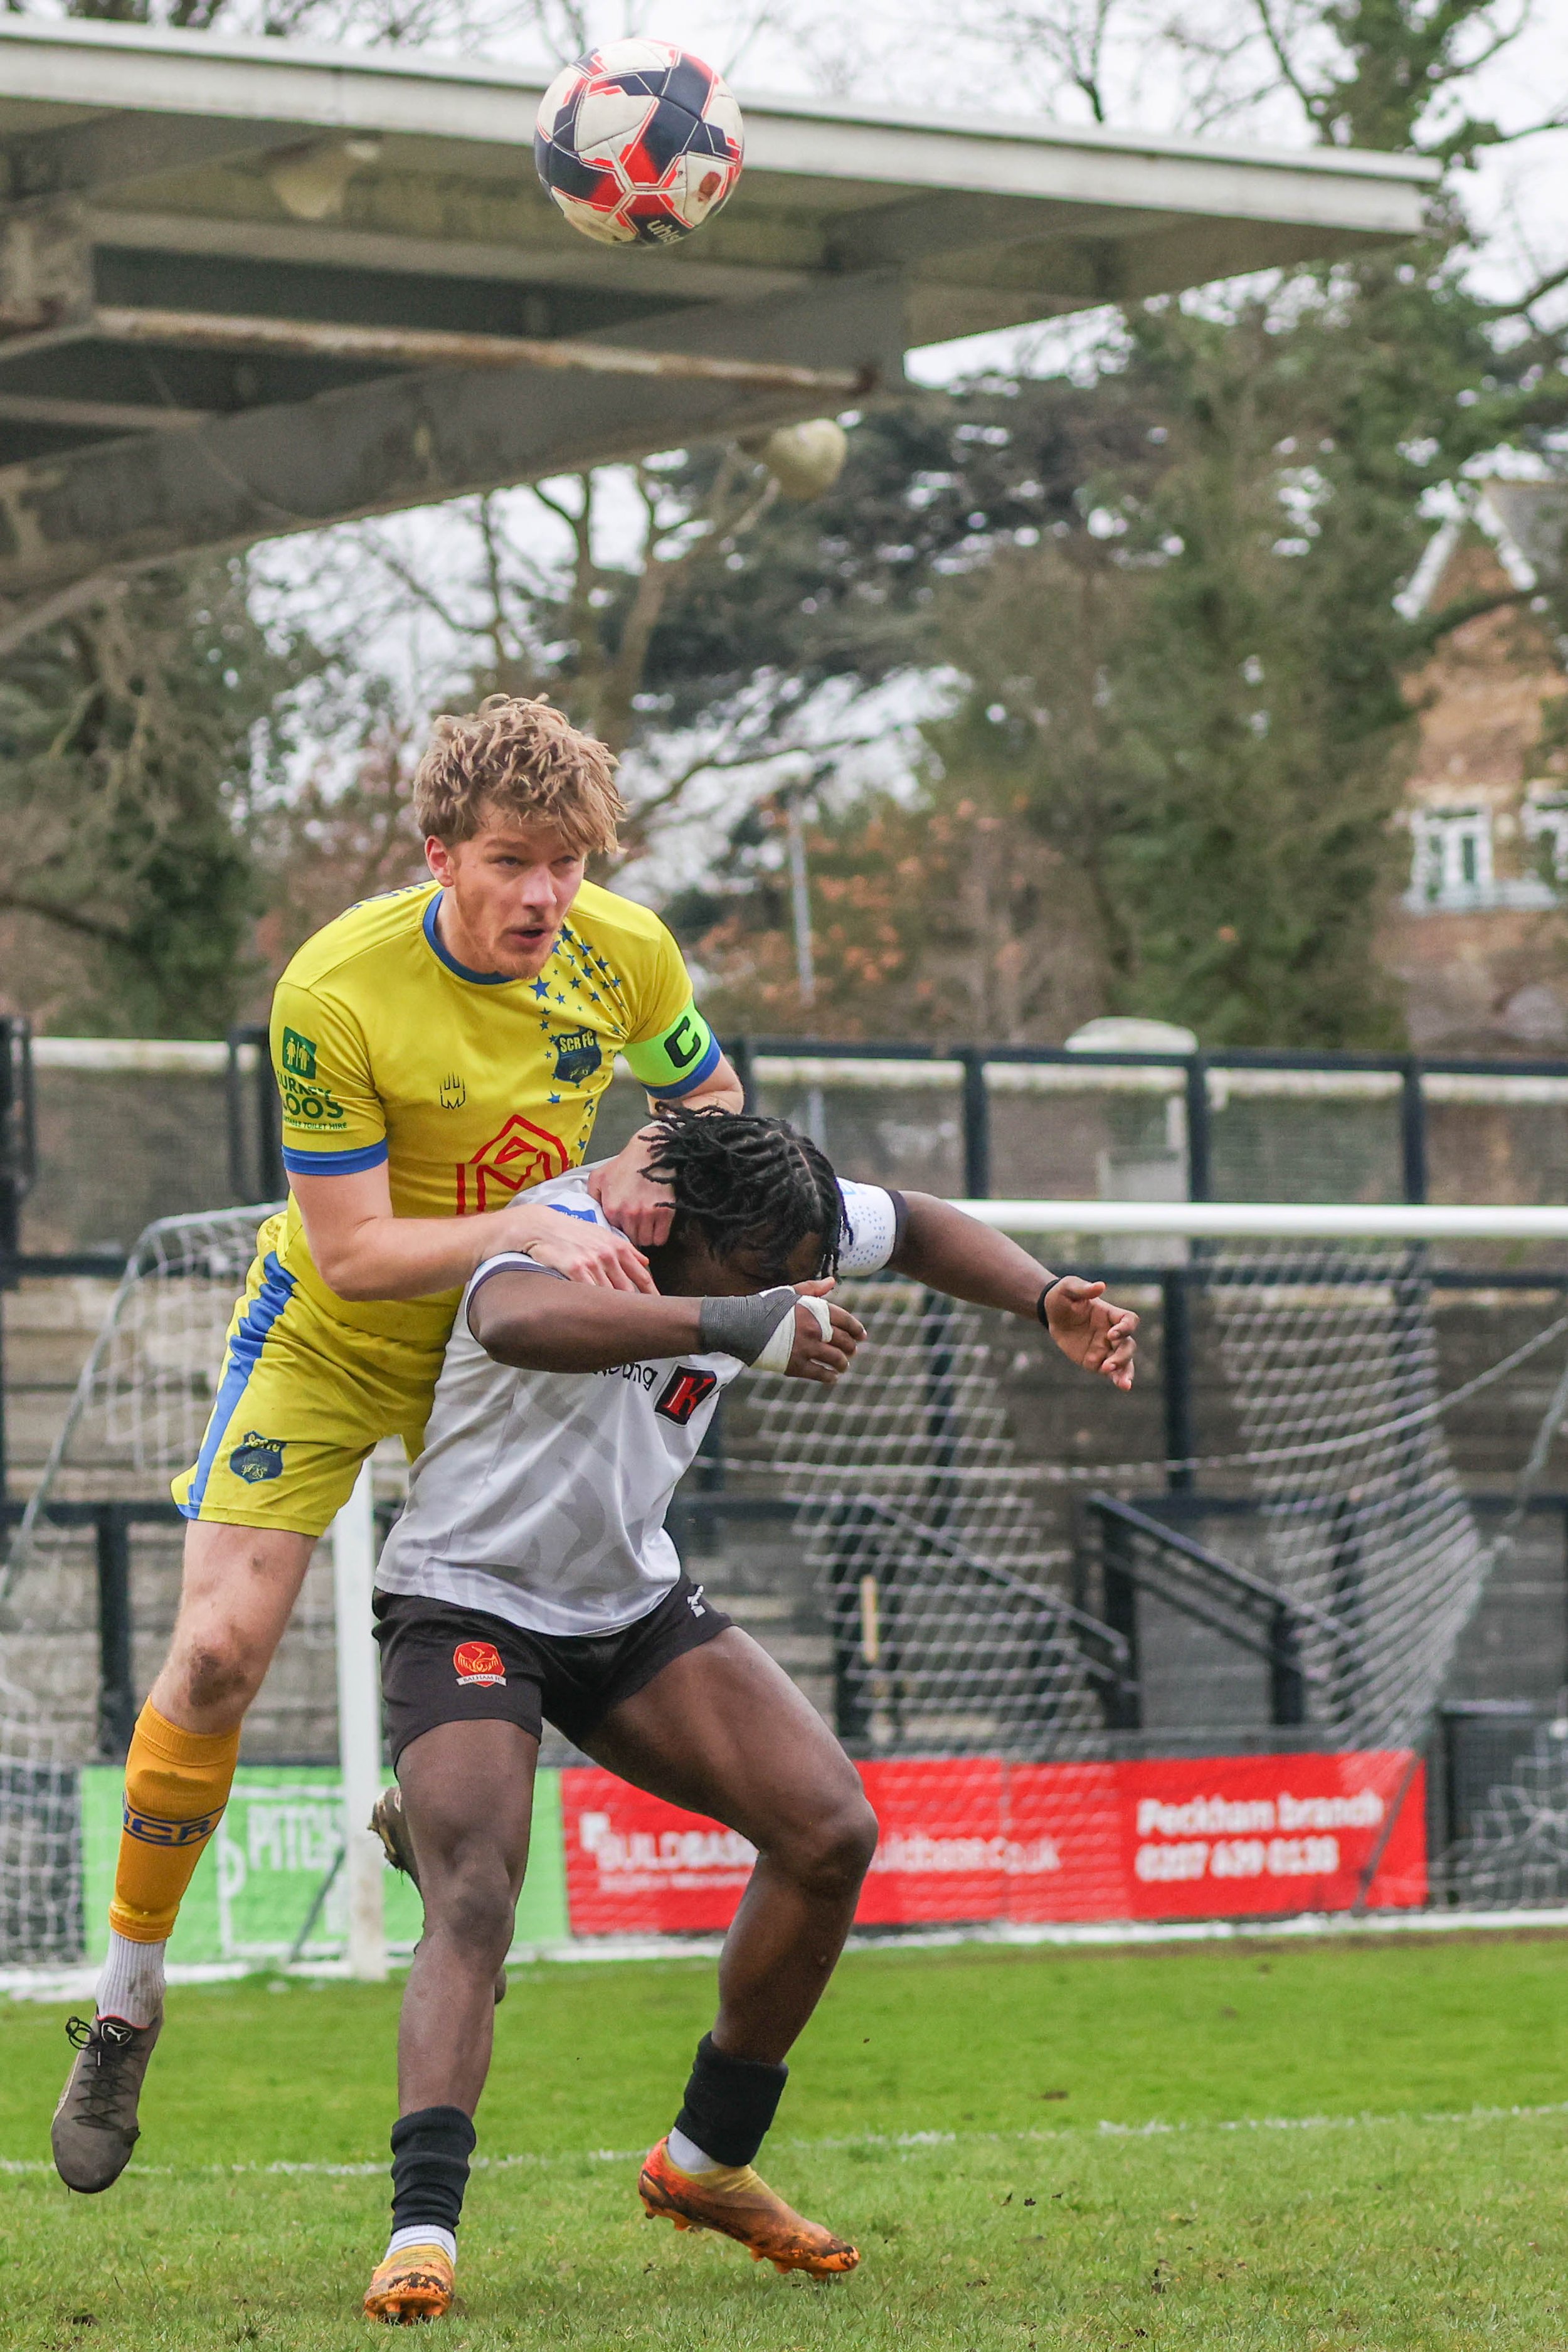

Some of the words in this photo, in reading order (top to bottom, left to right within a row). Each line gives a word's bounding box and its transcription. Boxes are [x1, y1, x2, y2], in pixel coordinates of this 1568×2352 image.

[559, 1037, 581, 1052] SCR
[582, 1030, 594, 1048] FC
[664, 1015, 701, 1067] C
[660, 1375, 716, 1416] K
[124, 1809, 211, 1841] CR
[1136, 1795, 1276, 1836] Peckham
[1278, 1788, 1384, 1830] branch
